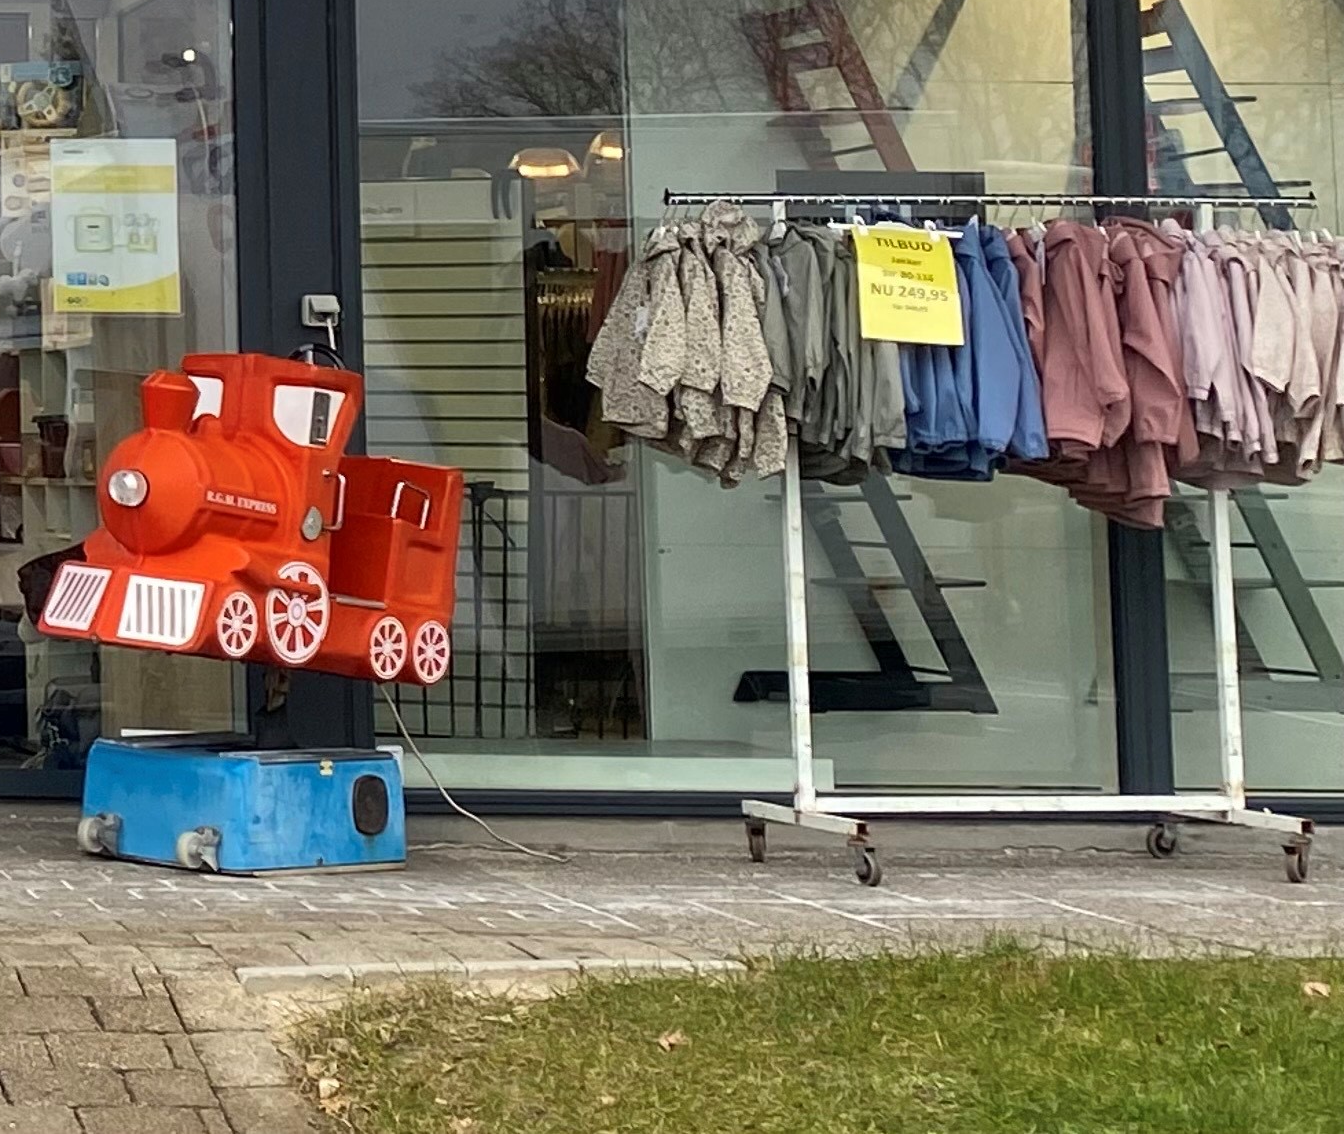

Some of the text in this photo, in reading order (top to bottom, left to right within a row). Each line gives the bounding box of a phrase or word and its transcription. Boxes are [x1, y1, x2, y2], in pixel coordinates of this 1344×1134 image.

[875, 237, 935, 253] TILBUD
[870, 282, 950, 303] NU 249,95
